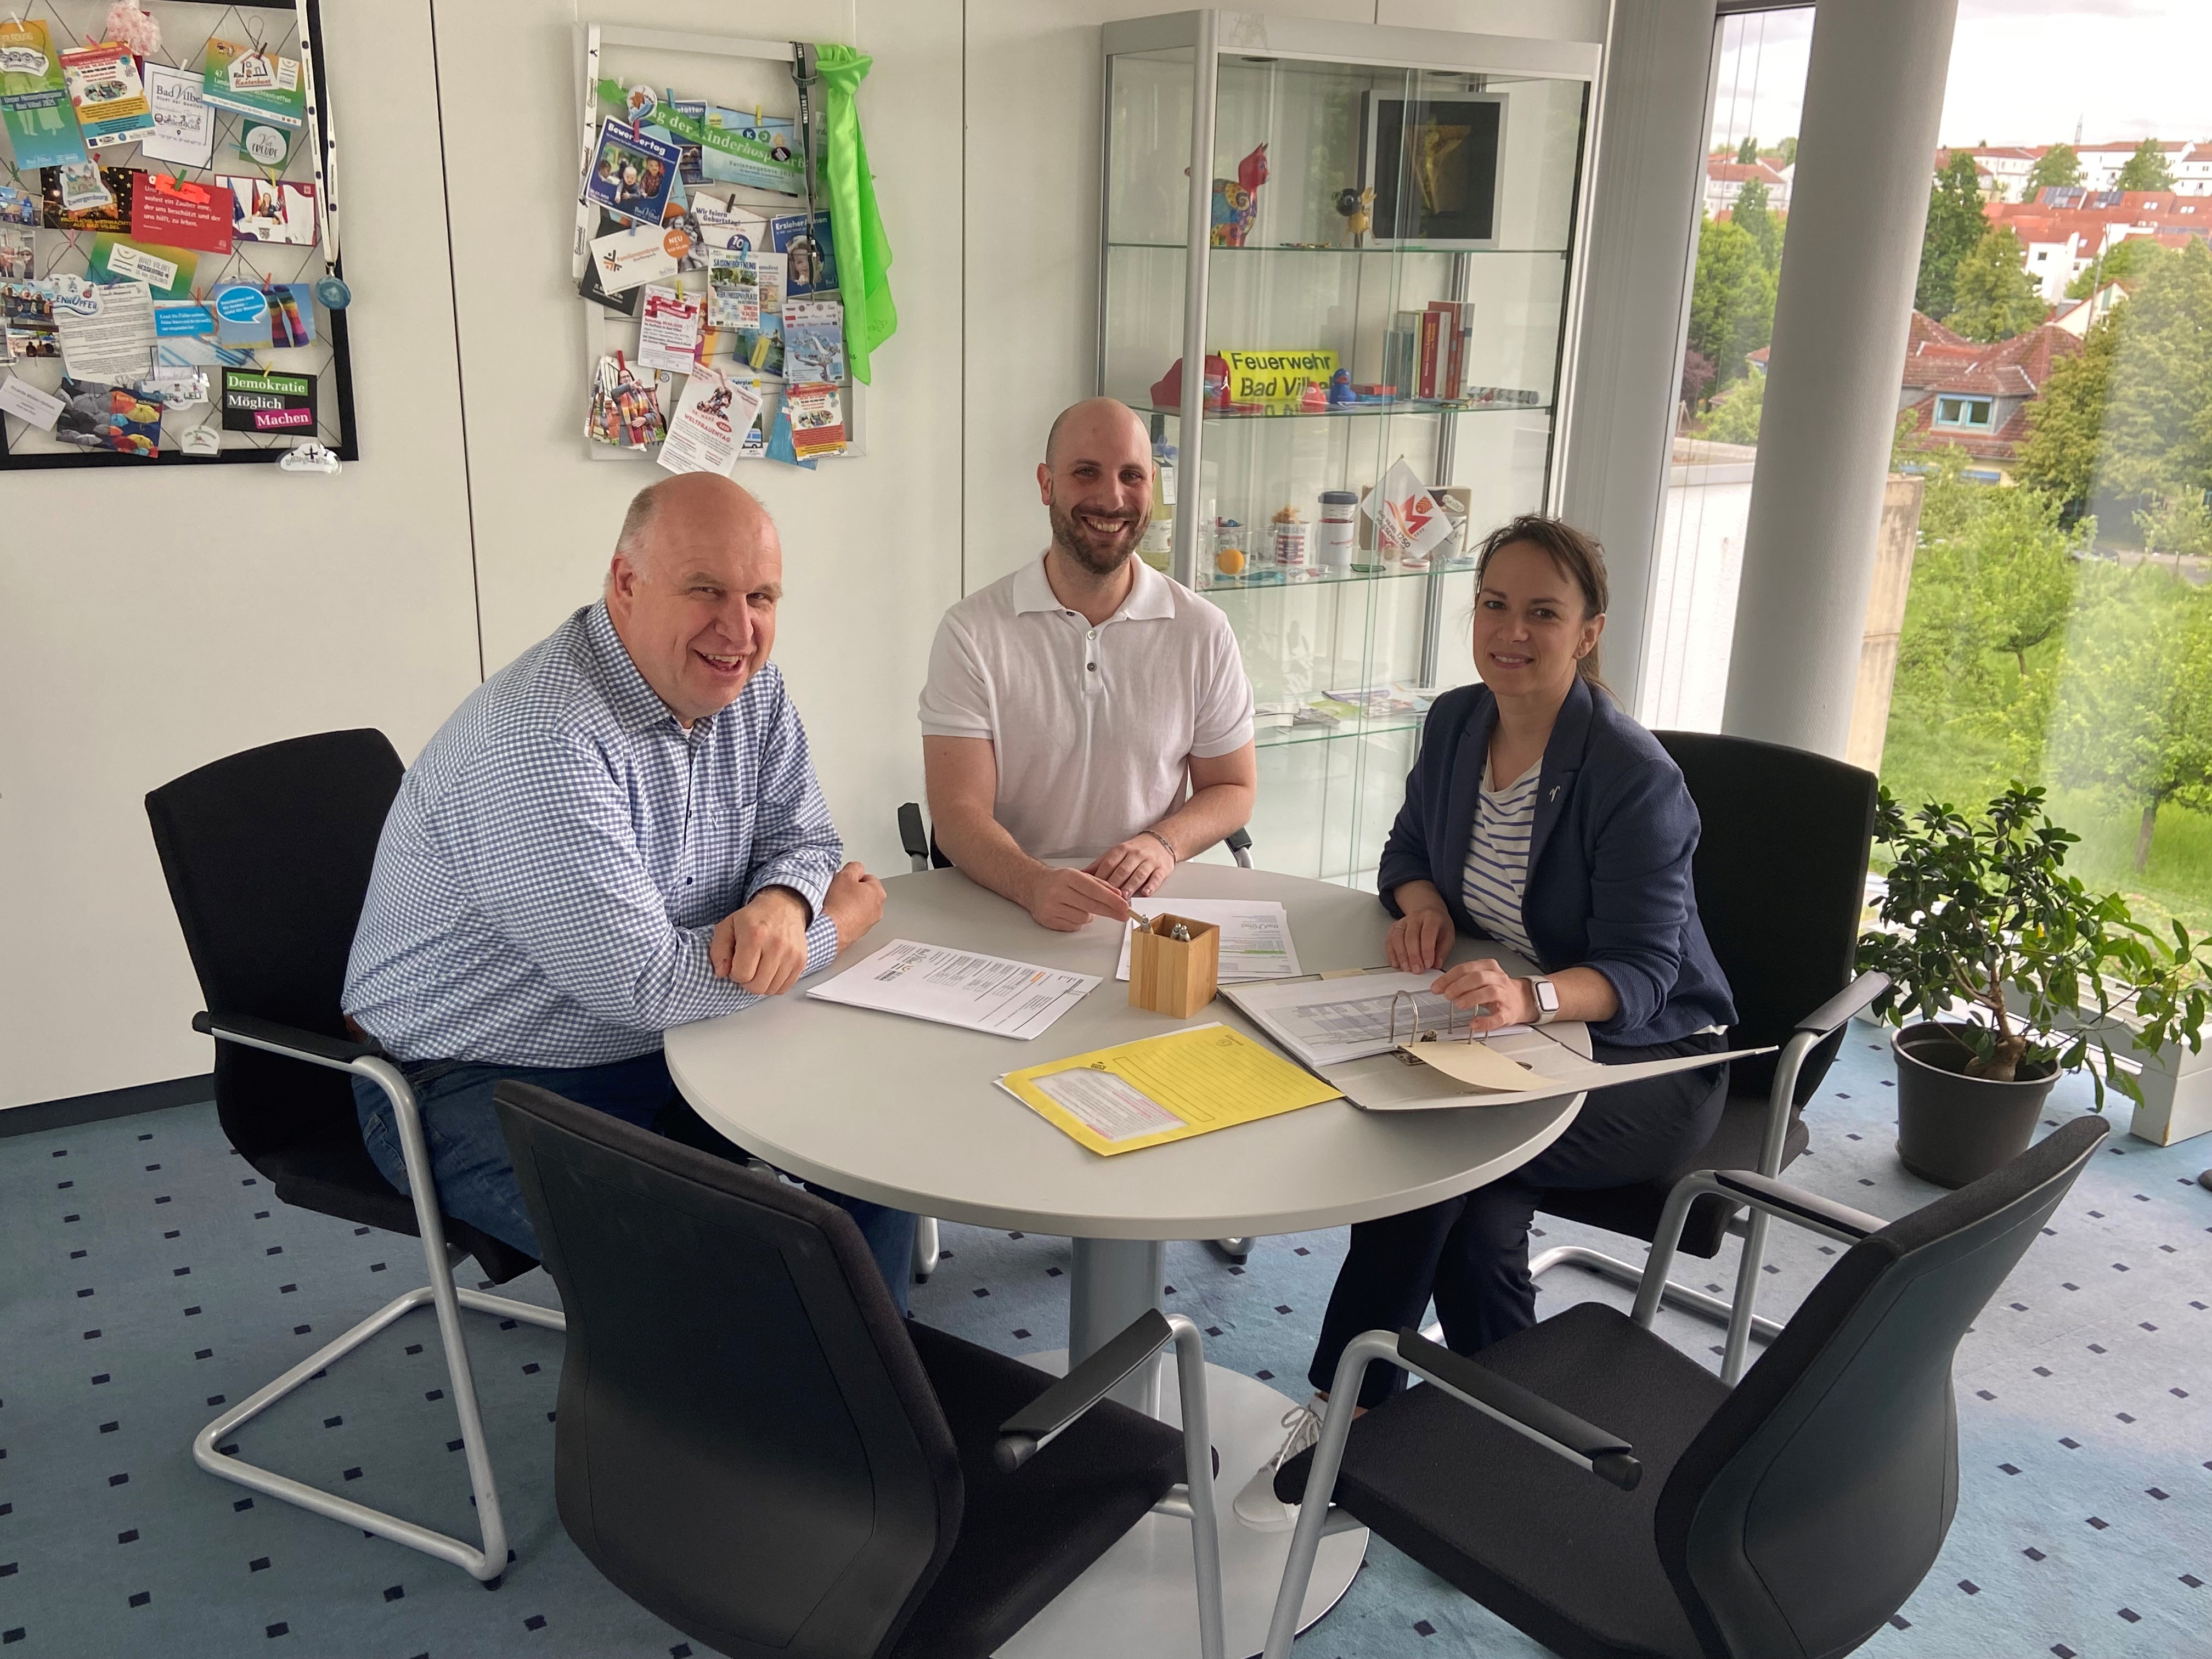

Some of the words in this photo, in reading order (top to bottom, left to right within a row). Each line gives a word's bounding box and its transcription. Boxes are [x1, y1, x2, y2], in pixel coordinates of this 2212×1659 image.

[156, 84, 174, 97] Bad
[670, 116, 693, 133] der
[608, 123, 666, 156] Bewerertag
[252, 143, 278, 157] FREUDE
[729, 161, 778, 174] Ferienangebote
[66, 195, 109, 206] Zwergenburg
[144, 195, 163, 204] wohnt
[175, 200, 196, 208] Zauber
[168, 207, 196, 218] beschützt
[709, 210, 727, 218] feiern
[180, 218, 198, 227] leben.
[703, 215, 741, 227] Geburtstag!
[669, 235, 683, 244] NEU
[732, 235, 744, 249] 10
[139, 256, 151, 266] BAD
[153, 261, 171, 274] VILBEL
[1231, 353, 1331, 370] Feuerwehr
[228, 375, 305, 393] Demokratie
[1240, 377, 1277, 397] Bad
[229, 394, 282, 410] Möglich
[256, 412, 309, 426] Machen
[685, 414, 731, 442] WELTFRAUENTAG
[1278, 526, 1306, 534] HESSEN
[1376, 517, 1406, 549] MASSENHEIM
[1385, 518, 1397, 534] VILBEL
[1396, 531, 1412, 548] 1250
